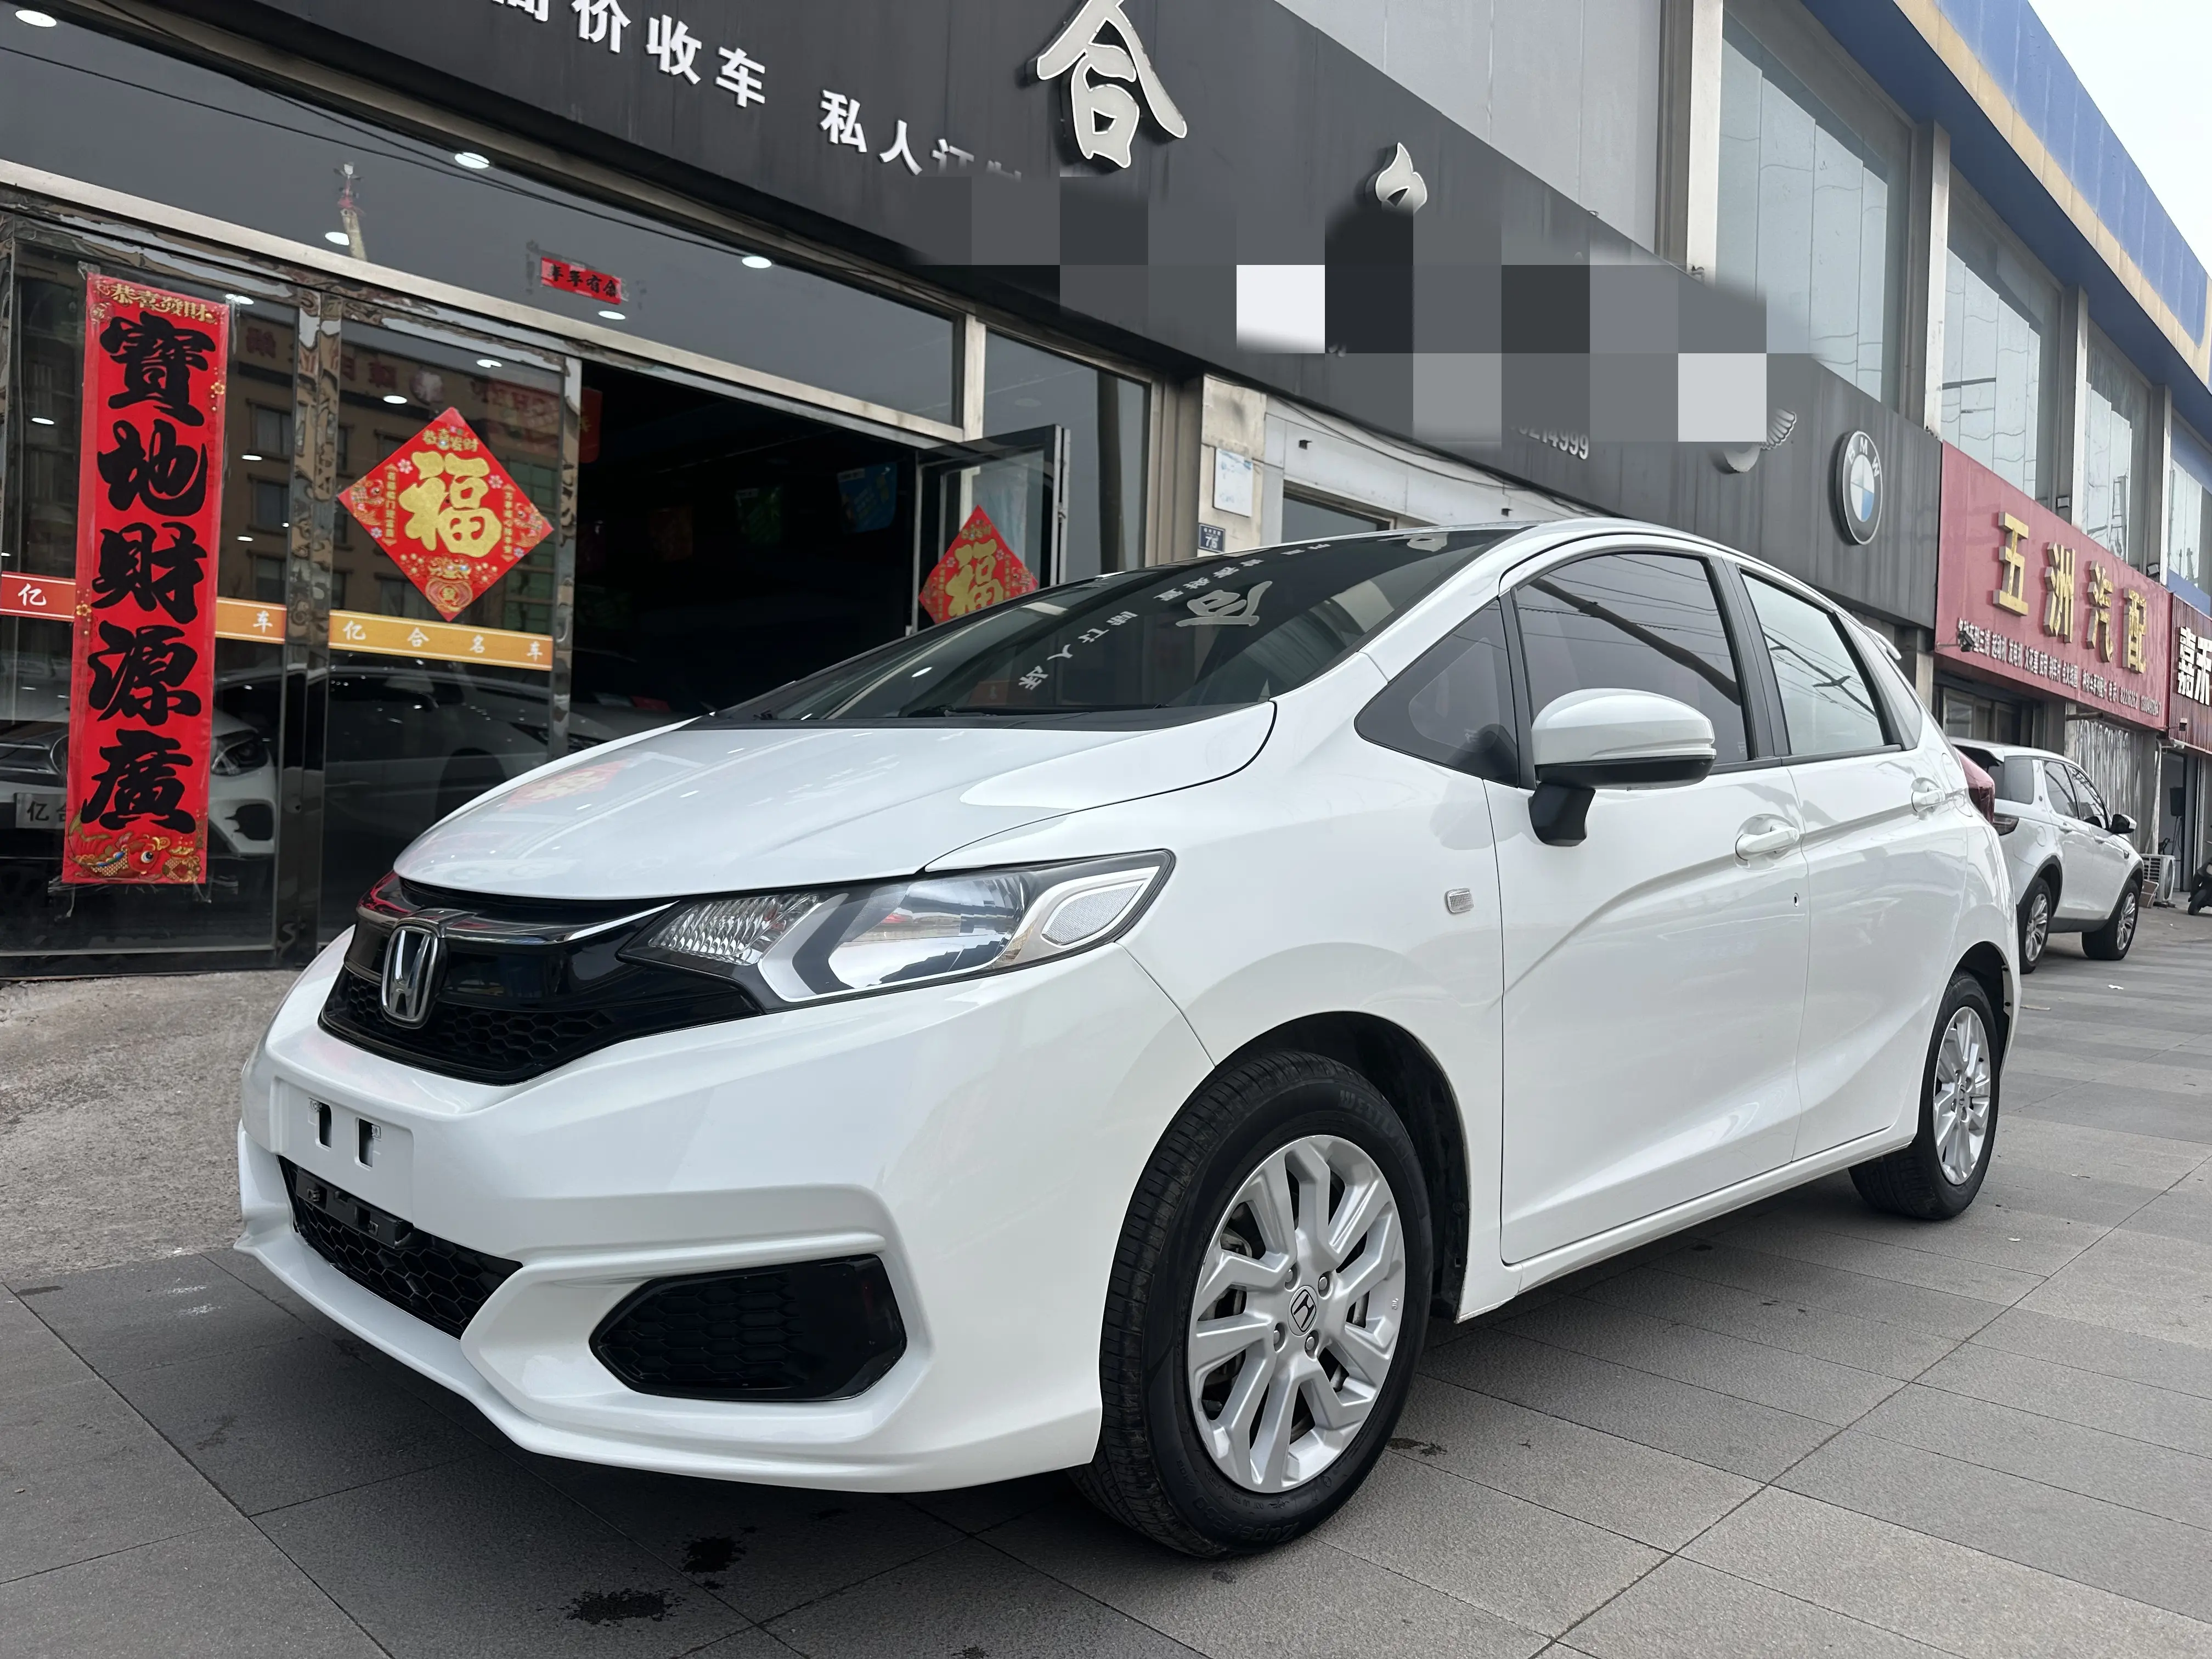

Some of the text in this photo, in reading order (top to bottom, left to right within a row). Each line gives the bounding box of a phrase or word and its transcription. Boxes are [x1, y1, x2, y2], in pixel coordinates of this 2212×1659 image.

[1036, 0, 1187, 168] 合
[1847, 437, 1880, 477] BMW
[399, 450, 502, 558] 福
[17, 583, 273, 633] 亿 车
[945, 539, 1004, 617] 福
[342, 620, 543, 661] 亿合名车
